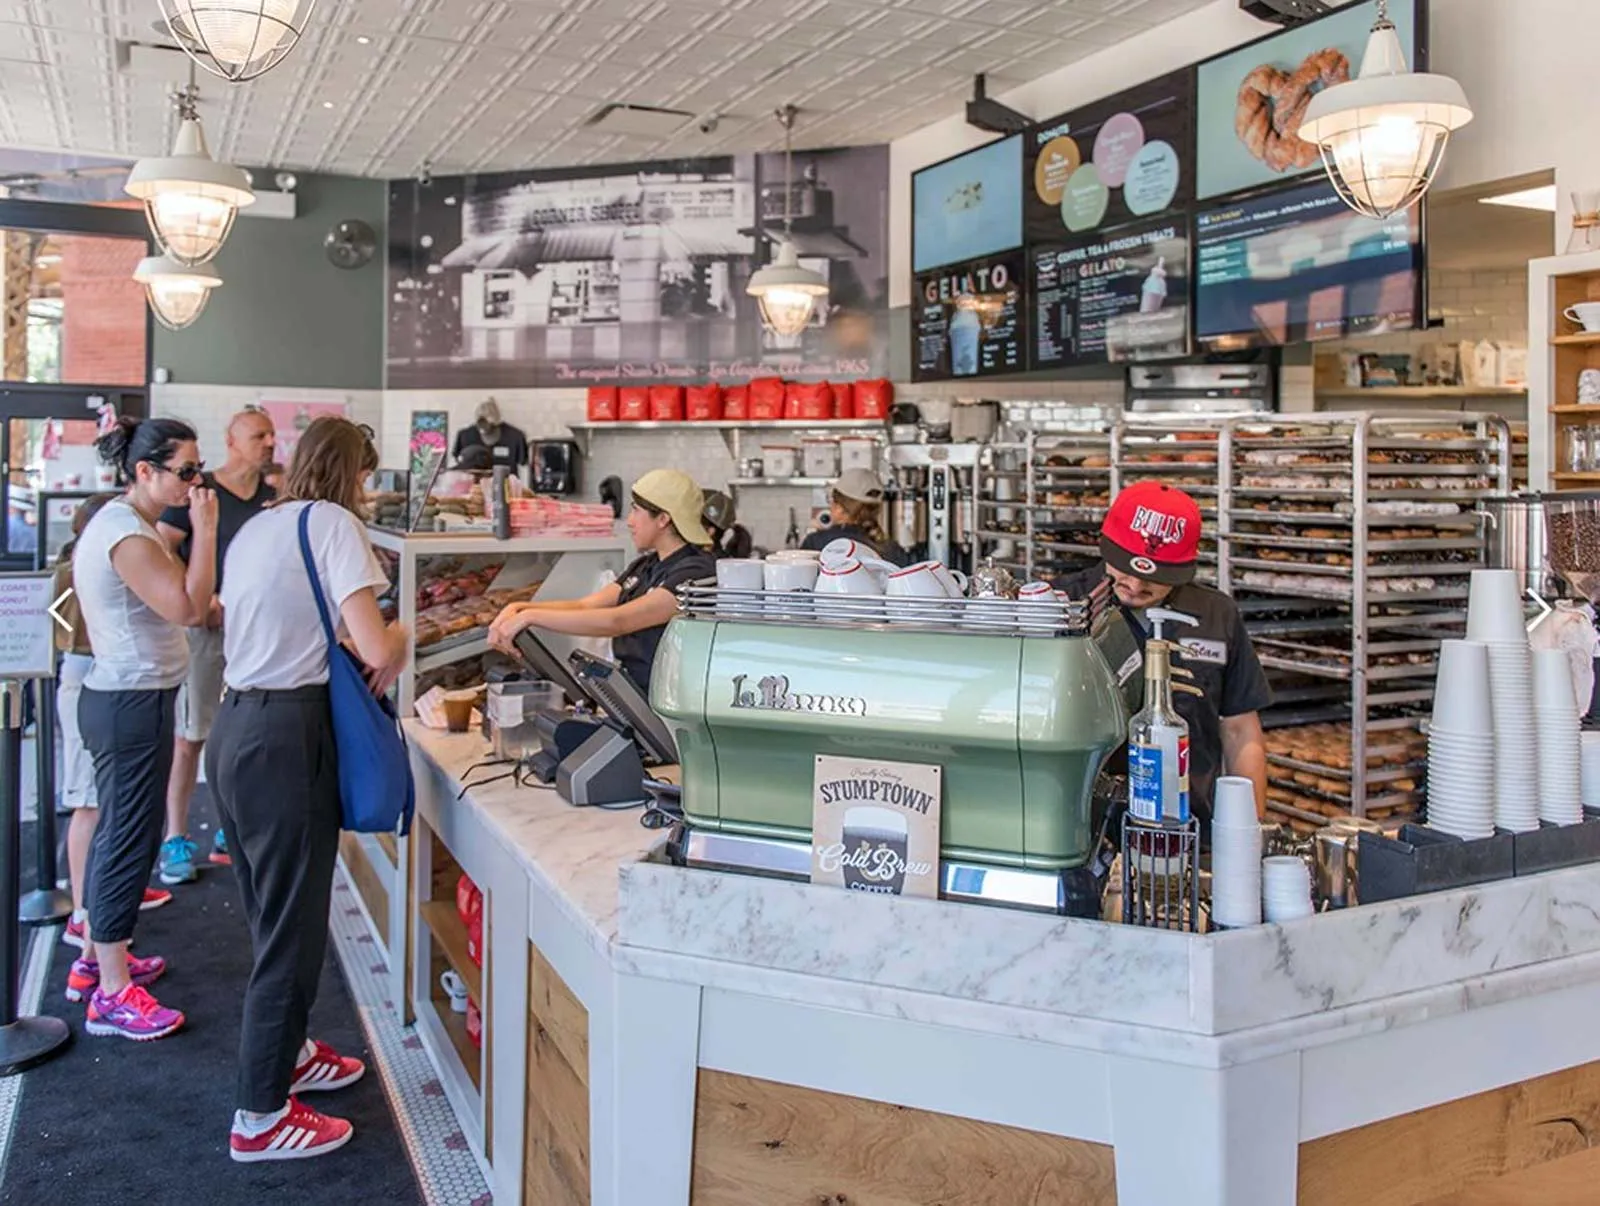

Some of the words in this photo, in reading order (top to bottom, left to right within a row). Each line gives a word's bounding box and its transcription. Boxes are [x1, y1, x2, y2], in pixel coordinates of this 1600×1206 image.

[925, 263, 1008, 302] GELATO
[1079, 256, 1126, 278] GELATO
[835, 359, 870, 375] 1965
[1129, 503, 1187, 544] BULLS
[1187, 641, 1221, 659] Stan
[819, 778, 934, 815] STUMPTOWN
[816, 842, 871, 873] Cold
[867, 847, 933, 881] Brew
